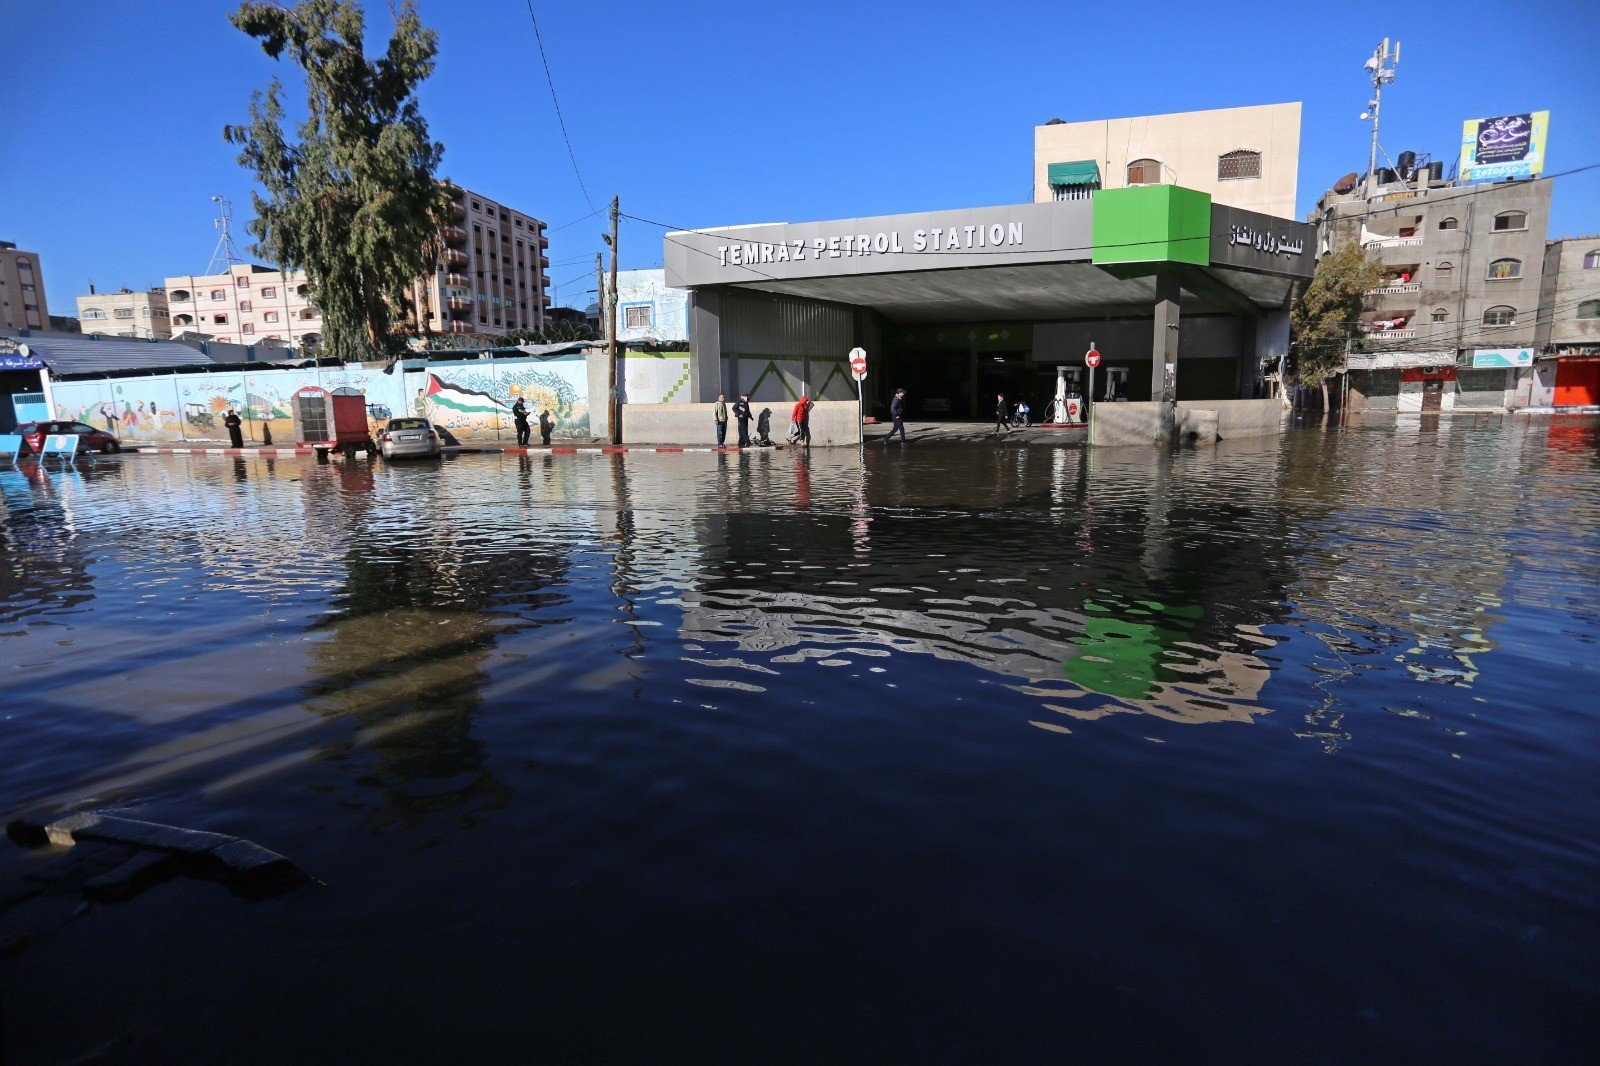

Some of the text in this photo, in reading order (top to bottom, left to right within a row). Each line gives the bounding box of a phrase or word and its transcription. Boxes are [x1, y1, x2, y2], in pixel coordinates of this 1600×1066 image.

[718, 221, 1025, 266] TEMRAZ PETROL STATION
[1229, 224, 1304, 259] للبترول والغاز
